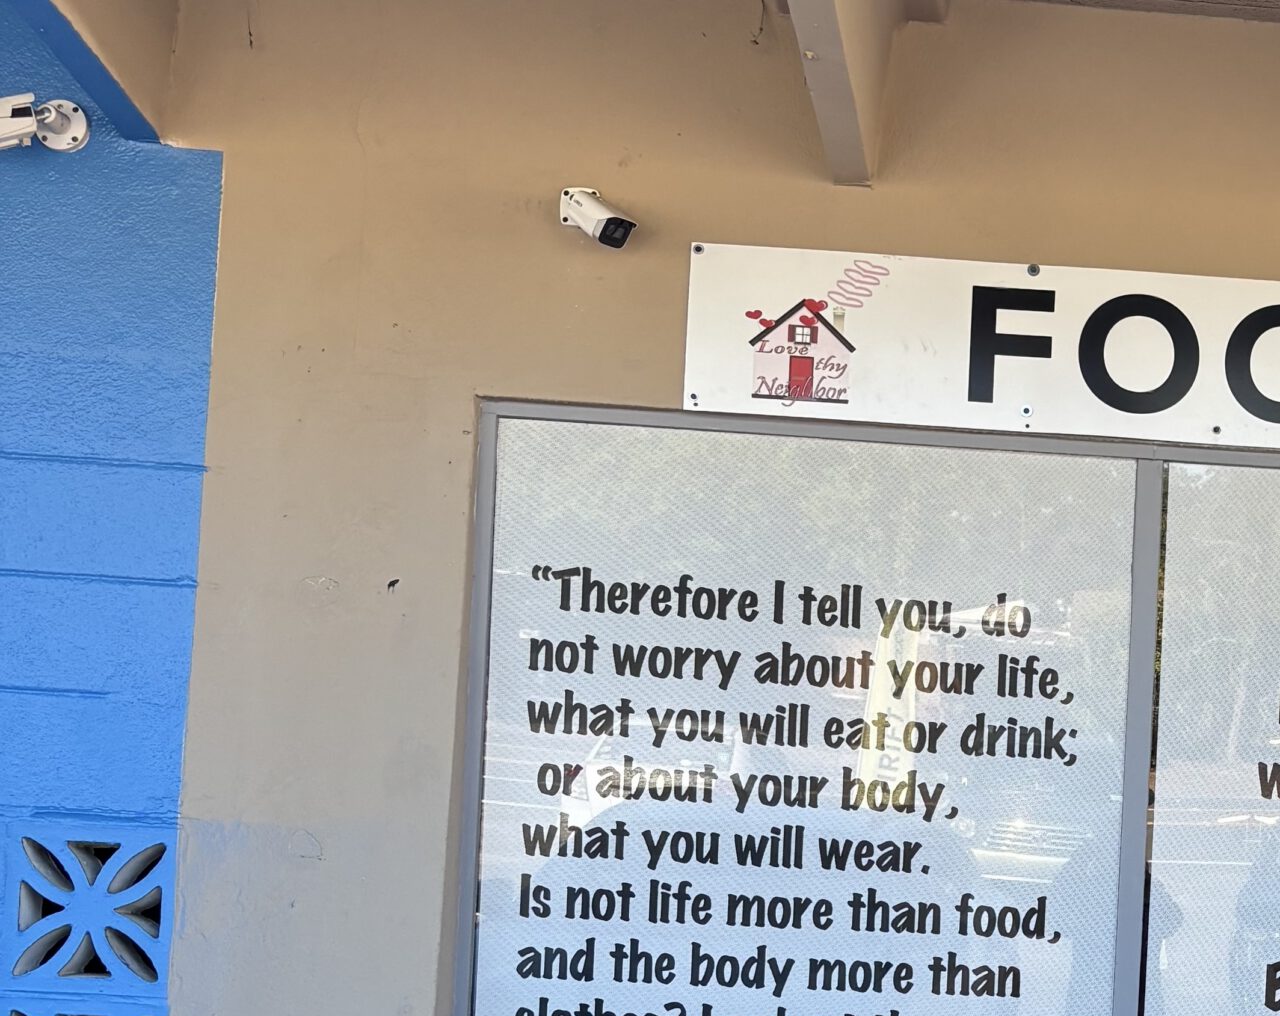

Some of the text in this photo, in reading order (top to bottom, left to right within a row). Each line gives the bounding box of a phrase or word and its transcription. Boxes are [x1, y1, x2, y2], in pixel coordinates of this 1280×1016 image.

[755, 340, 809, 355] Love
[815, 355, 848, 379] thy
[755, 376, 848, 406] Neighbor
[773, 580, 785, 624] I
[798, 584, 862, 629] tell
[875, 598, 965, 638] you,
[982, 593, 1031, 637] do
[529, 635, 1073, 704] not worry about your life,
[527, 690, 1078, 767] what you will eat or drink;
[538, 757, 958, 822] or about your body,
[522, 813, 930, 874] what you will wear.
[520, 874, 1061, 943] Is not life more than food,
[516, 937, 1020, 998] and the body more than
